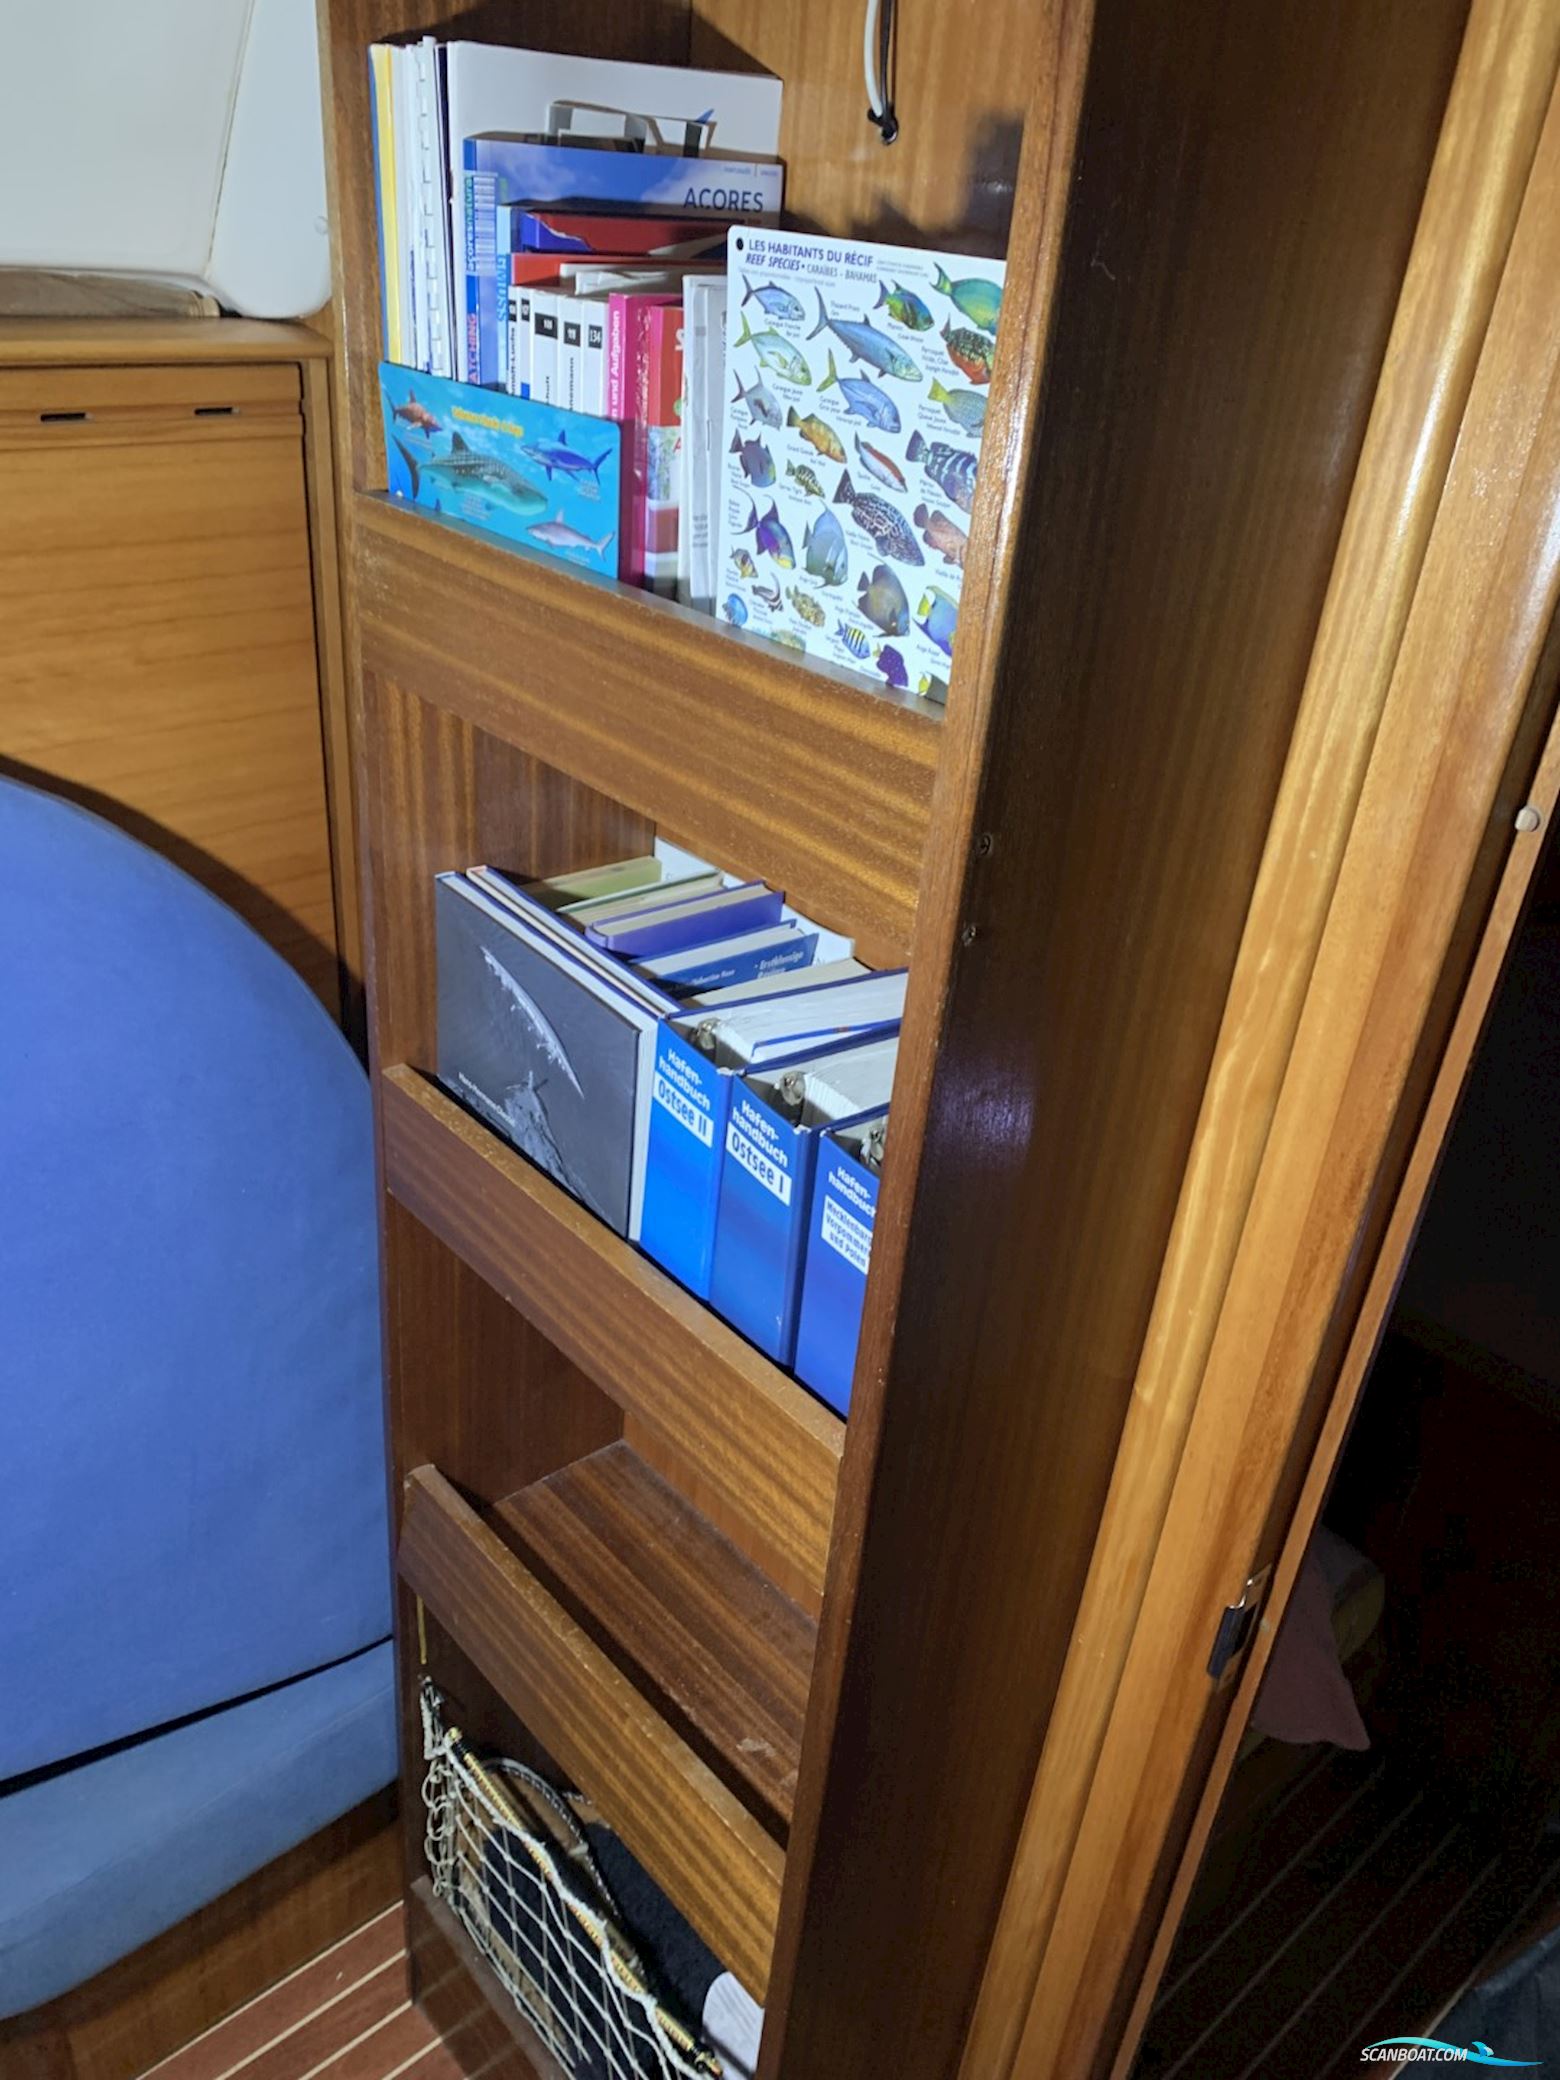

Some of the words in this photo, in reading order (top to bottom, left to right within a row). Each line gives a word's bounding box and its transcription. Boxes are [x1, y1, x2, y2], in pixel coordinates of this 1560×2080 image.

[745, 253, 766, 266] REEF
[768, 255, 801, 271] SPECIES
[844, 270, 878, 284] BAHAMAS
[749, 239, 766, 251] LES
[767, 242, 824, 261] HABITANTS
[827, 249, 842, 263] DU
[844, 251, 874, 267] RÉCIF
[610, 310, 621, 378] Aufgaben
[611, 379, 619, 406] und
[659, 1056, 710, 1111] handbuch
[668, 1048, 702, 1085] Hafen-
[658, 1080, 695, 1126] Ostsee
[698, 1113, 707, 1137] II
[742, 1100, 779, 1140] Hafen-
[733, 1107, 788, 1168] handbuch
[732, 1132, 775, 1185] Ostsee
[837, 1166, 871, 1199] Hafen-
